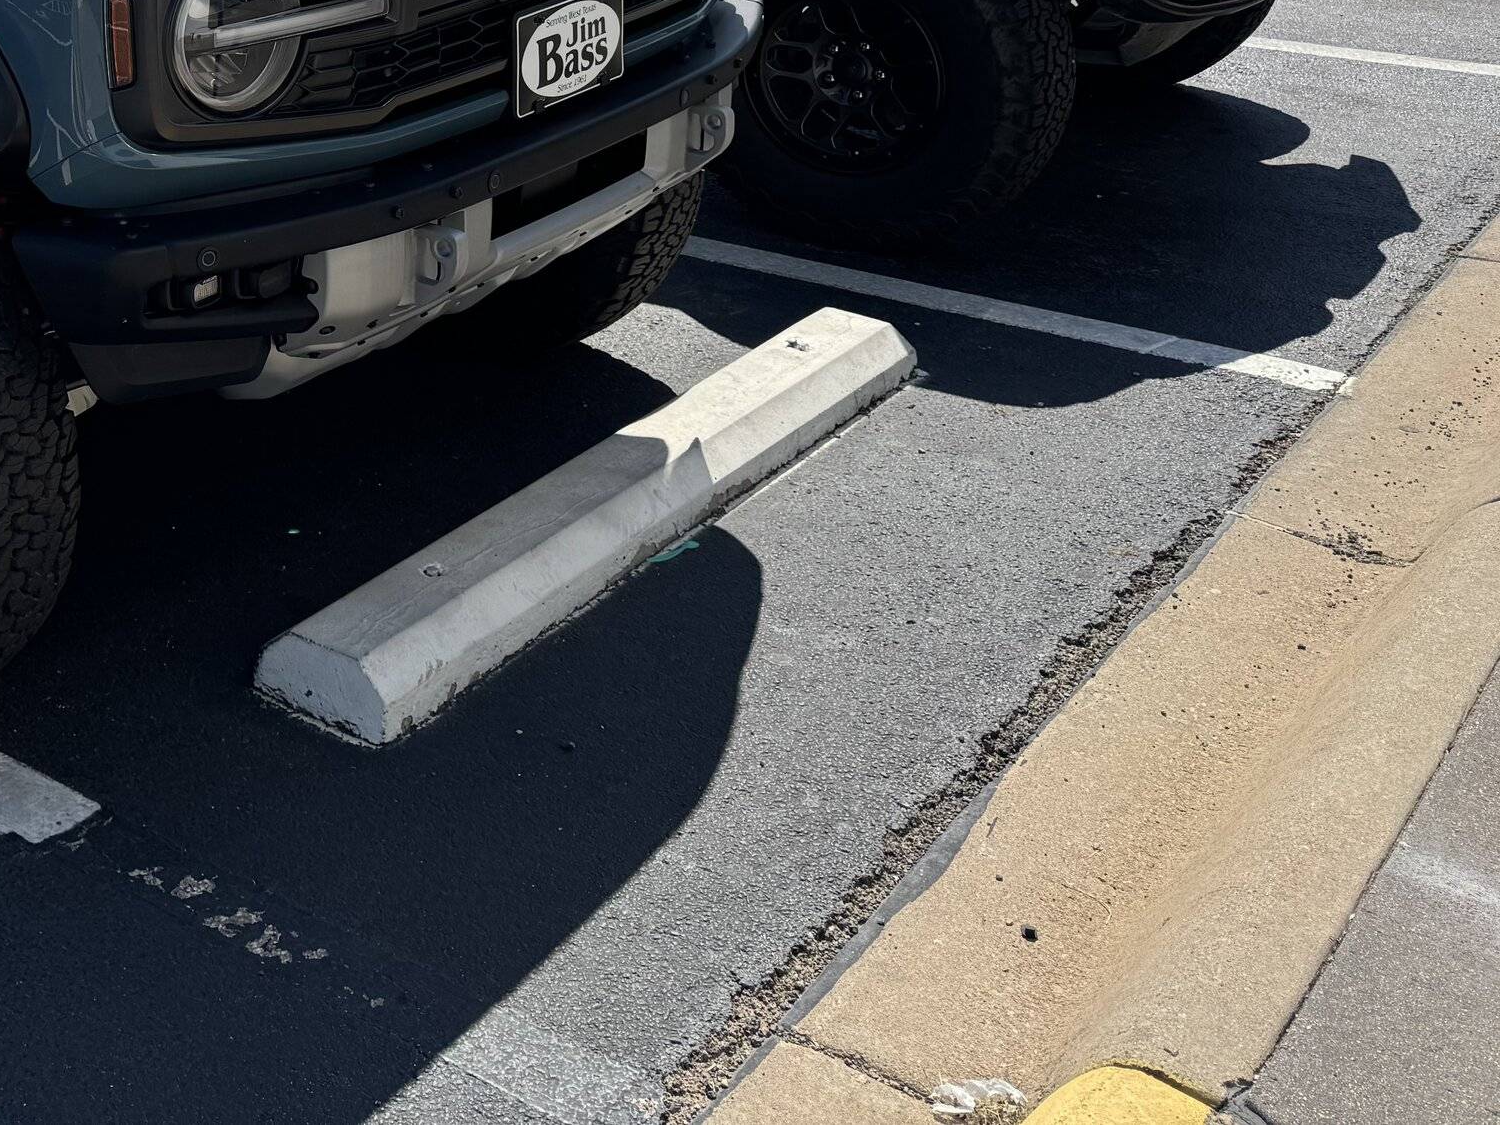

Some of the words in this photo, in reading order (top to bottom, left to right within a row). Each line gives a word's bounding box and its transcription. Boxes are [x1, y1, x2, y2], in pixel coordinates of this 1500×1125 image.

[546, 13, 568, 28] Serving
[568, 9, 581, 22] West
[582, 3, 597, 15] Texas
[566, 16, 607, 48] Jim
[536, 33, 608, 90] Bass
[557, 81, 573, 93] Since
[573, 74, 587, 88] 1961
